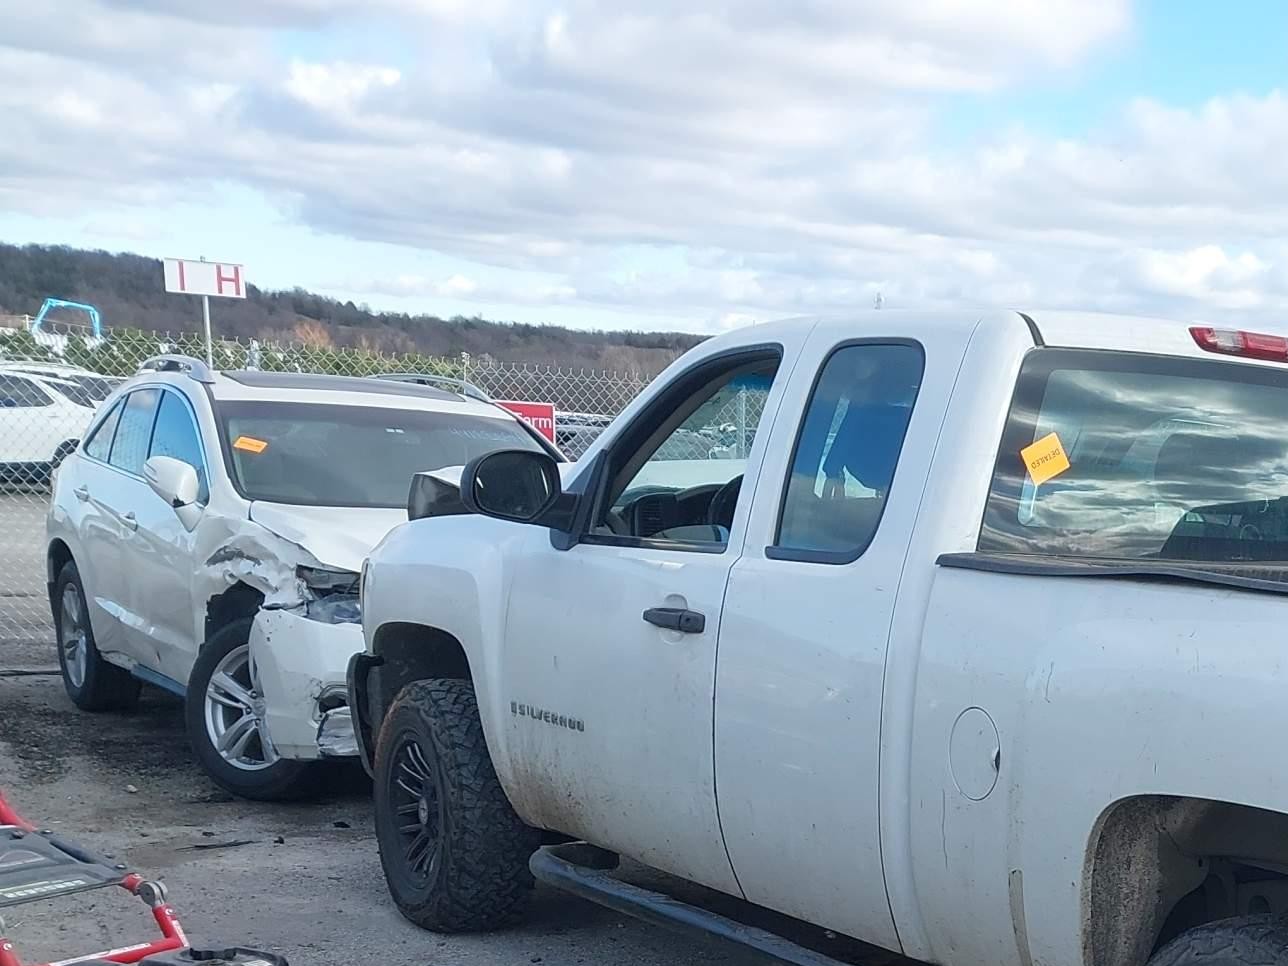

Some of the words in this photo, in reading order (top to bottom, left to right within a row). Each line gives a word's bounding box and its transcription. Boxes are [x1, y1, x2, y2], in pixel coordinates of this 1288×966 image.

[216, 264, 241, 296] H
[513, 412, 552, 429] arm
[518, 703, 585, 732] SILVERADO
